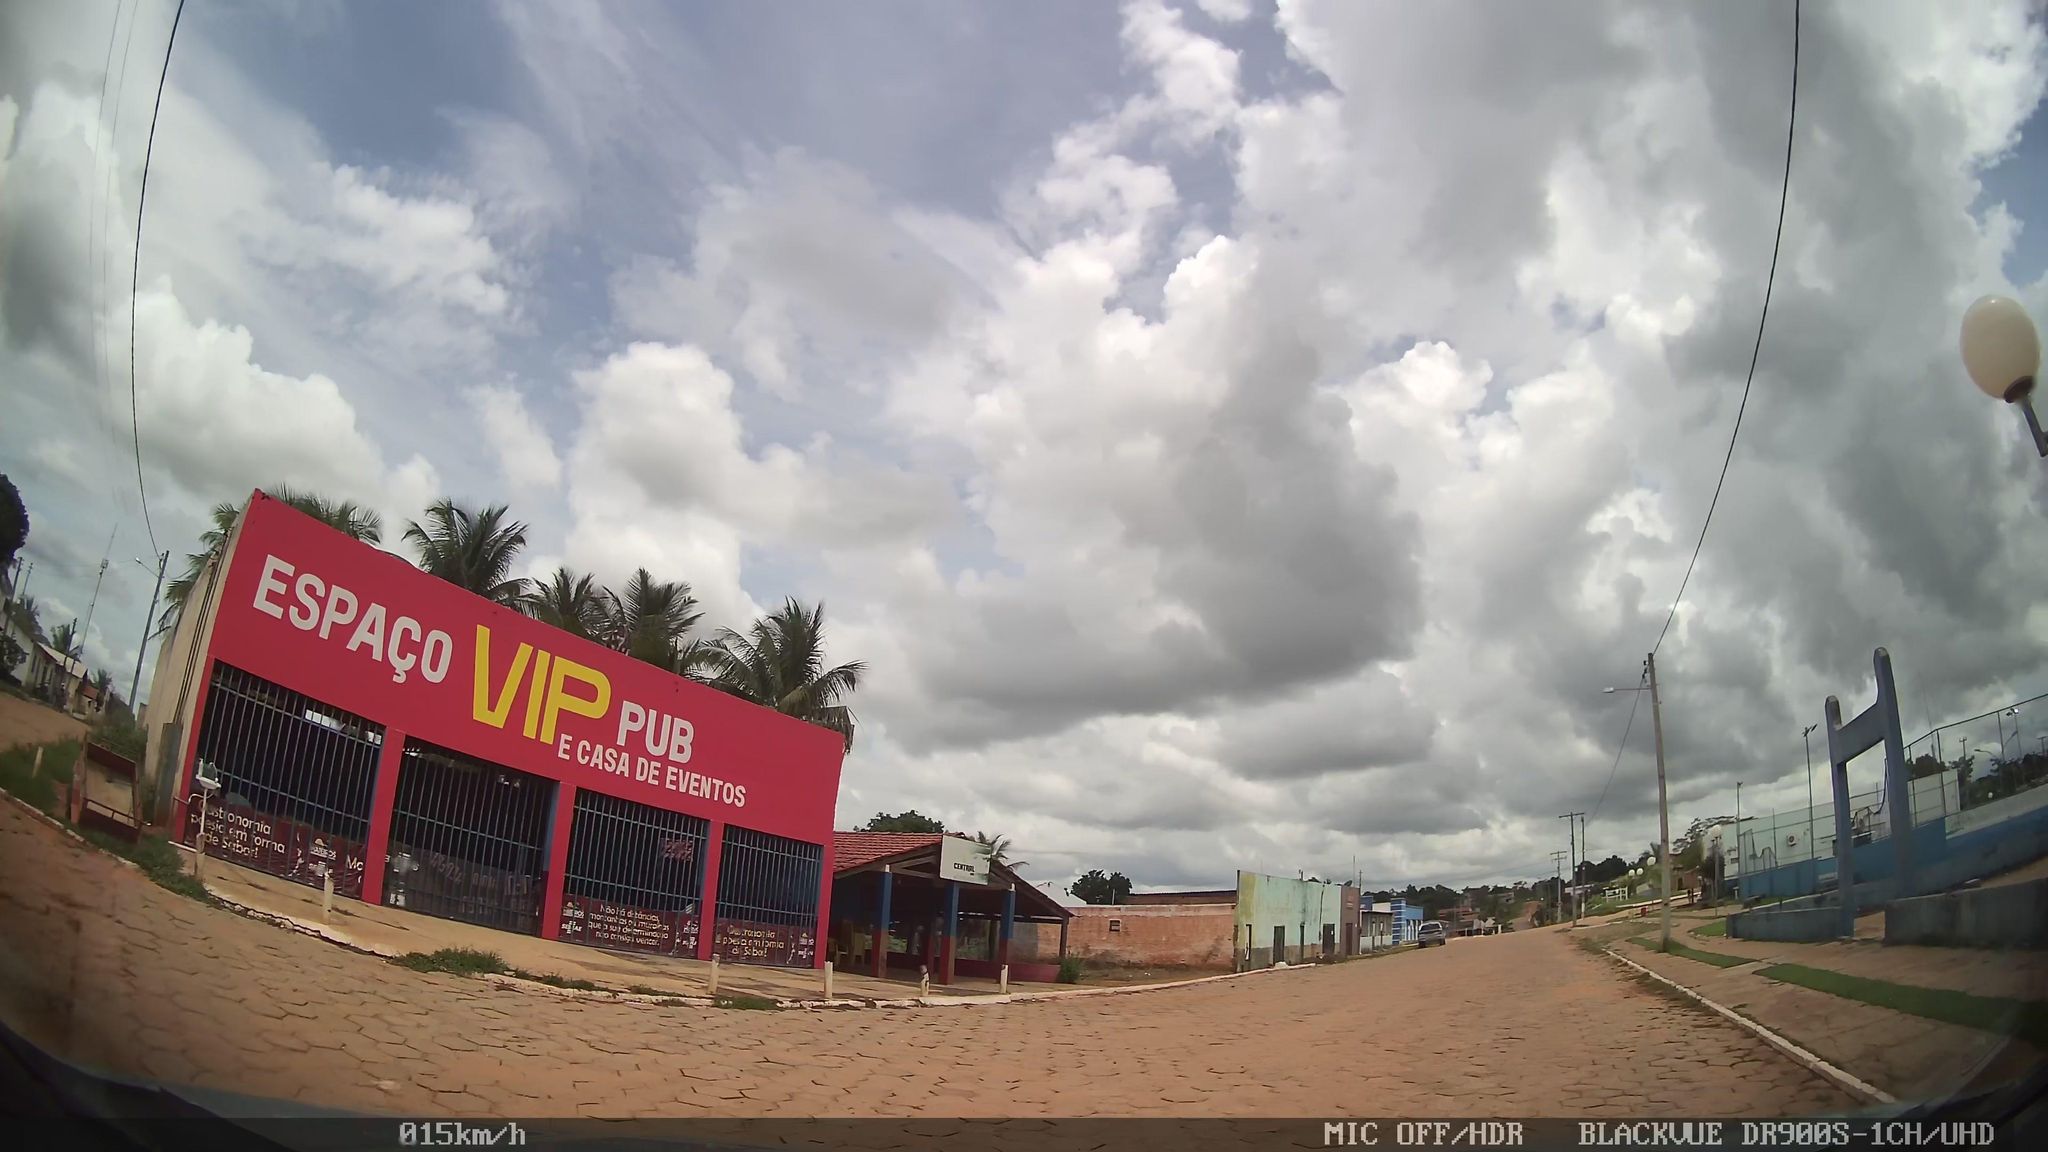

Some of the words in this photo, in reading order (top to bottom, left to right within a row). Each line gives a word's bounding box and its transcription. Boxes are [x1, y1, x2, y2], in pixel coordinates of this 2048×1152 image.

[253, 554, 453, 684] ESPAÇO
[473, 624, 611, 745] VIP
[617, 700, 694, 764] PUB
[557, 733, 573, 760] E
[577, 739, 630, 778] CASA
[635, 757, 661, 786] DE
[665, 766, 747, 808] EVENTOS
[191, 814, 224, 833] posia
[252, 831, 285, 853] orma
[199, 802, 271, 834] stonomia
[590, 913, 627, 925] monanhas
[595, 931, 609, 939] no
